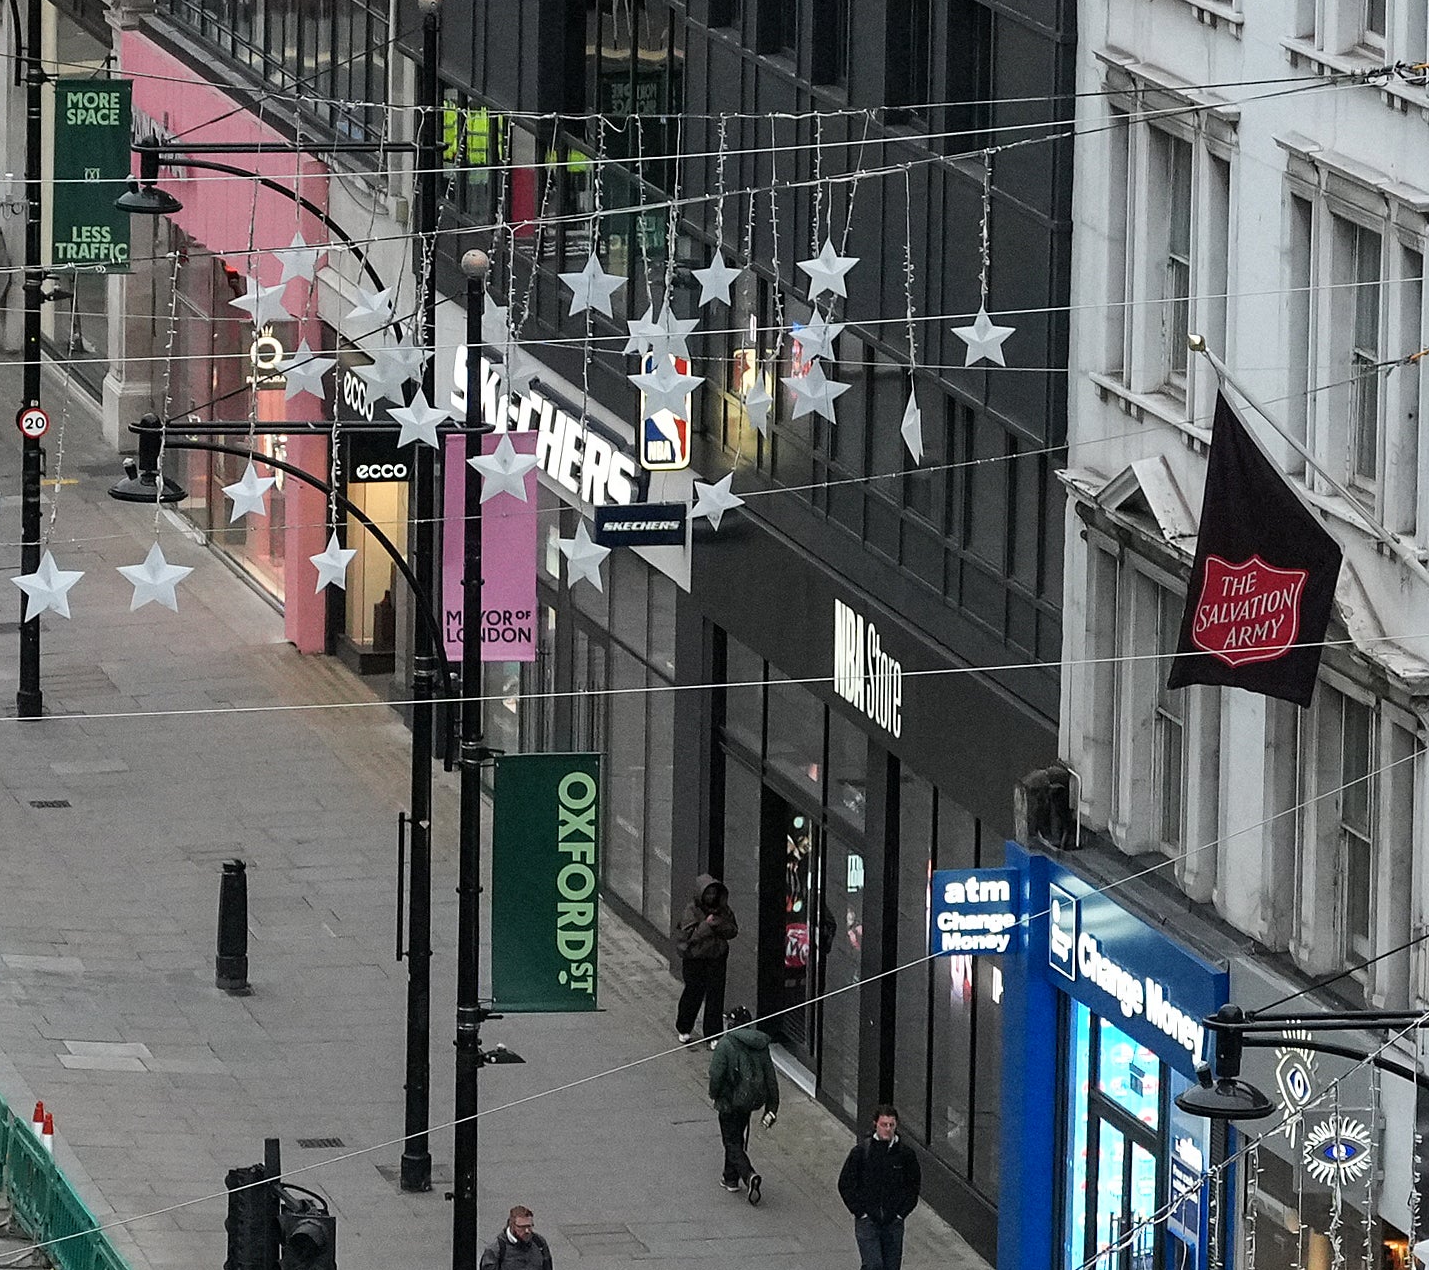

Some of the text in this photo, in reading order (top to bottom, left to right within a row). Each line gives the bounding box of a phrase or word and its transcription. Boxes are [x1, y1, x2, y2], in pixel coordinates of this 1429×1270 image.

[66, 92, 121, 108] MORE
[66, 109, 121, 126] SPACE
[71, 226, 112, 243] LESS
[55, 242, 128, 260] TRAFFIC
[343, 370, 375, 423] ecco
[647, 440, 673, 462] NBA
[356, 462, 408, 480] ecco
[602, 520, 681, 532] SKECHERS
[1219, 570, 1258, 597] THE
[446, 610, 532, 626] MYOR OF
[1197, 583, 1296, 633] SALVATION
[1222, 616, 1286, 651] ARMY
[833, 598, 903, 740] NBA Store
[556, 771, 598, 995] OXFORD ST
[943, 875, 1011, 904] atm
[936, 910, 1017, 934] Change
[941, 928, 1012, 954] Money
[1077, 932, 1144, 1017] Change
[1145, 978, 1204, 1067] Money
